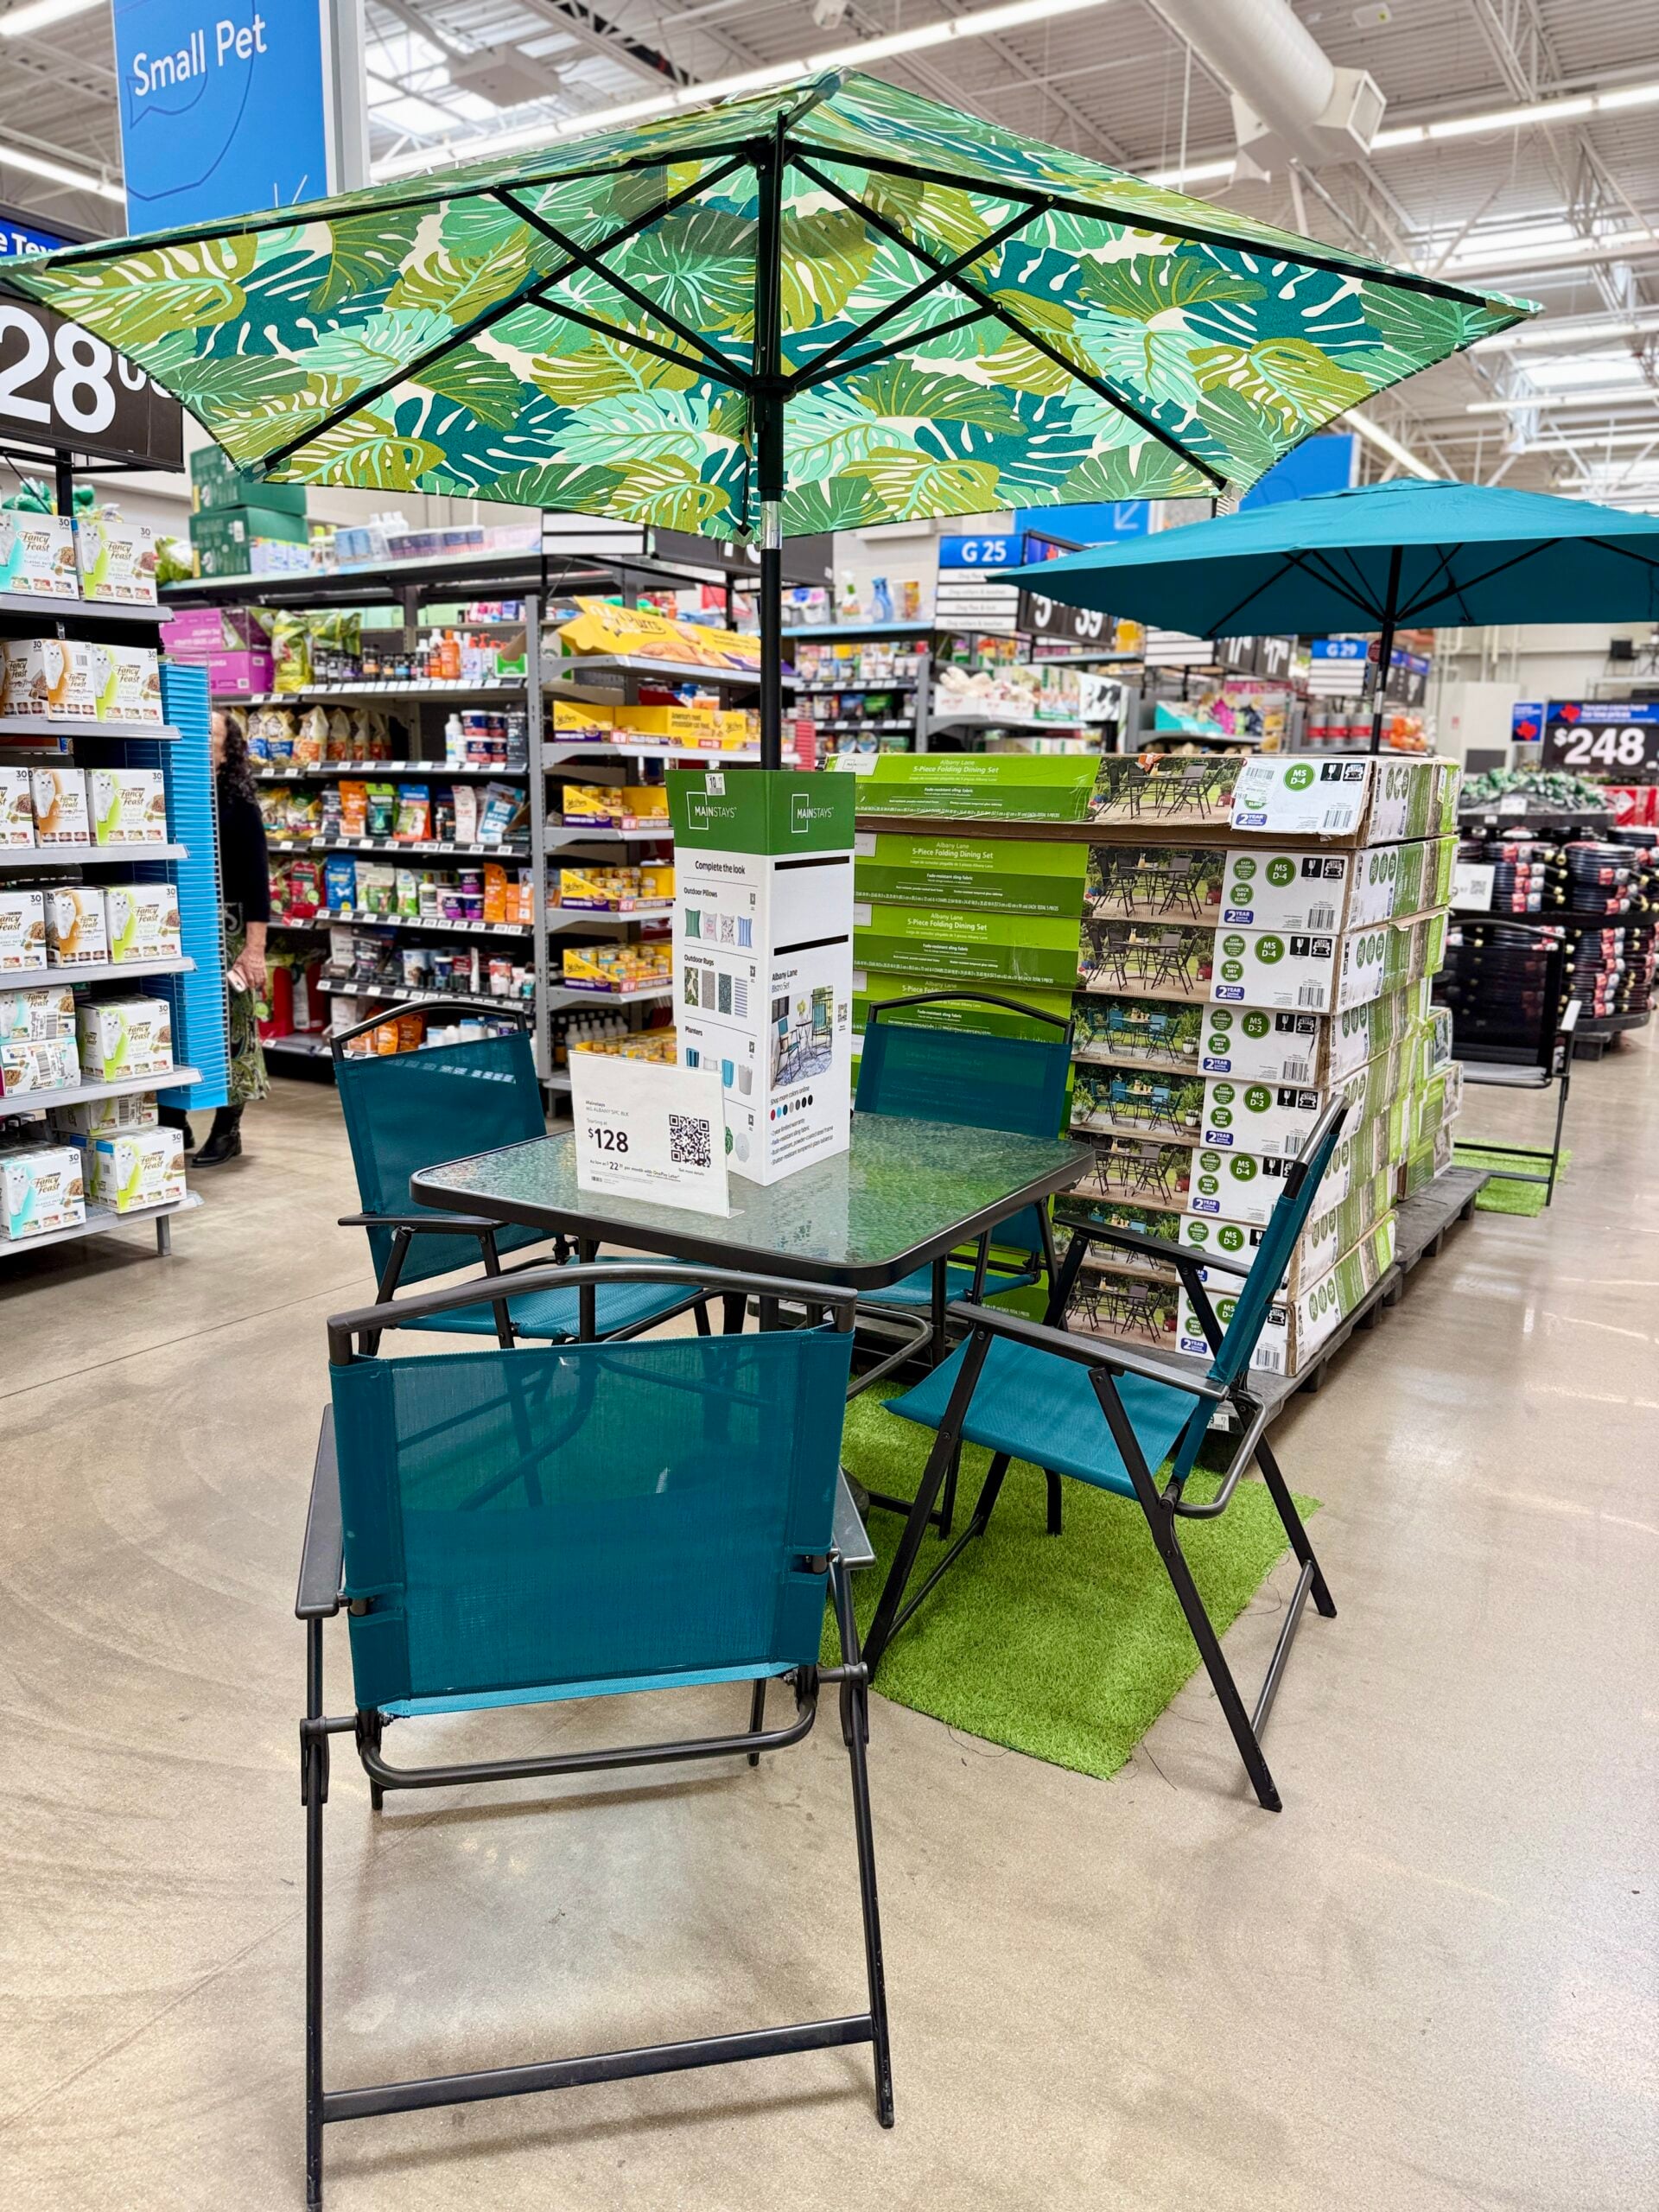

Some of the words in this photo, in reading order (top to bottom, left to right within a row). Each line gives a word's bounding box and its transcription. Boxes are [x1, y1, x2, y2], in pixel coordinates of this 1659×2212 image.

[133, 29, 206, 96] Small
[216, 14, 267, 67] Pet
[17, 531, 50, 543] Fancy
[26, 542, 50, 552] Feast
[104, 541, 132, 552] Fancy
[962, 541, 978, 563] G
[982, 541, 1007, 562] 25
[111, 550, 132, 560] Feast
[1326, 643, 1338, 657] G
[113, 666, 140, 676] Fancy
[119, 675, 140, 683] Feast
[1554, 728, 1645, 766] $248
[937, 766, 962, 774] Folding
[963, 766, 986, 774] Dining
[118, 789, 144, 799] Fancy
[123, 797, 145, 805] Feast
[695, 806, 734, 818] MAINSTAYS
[798, 808, 832, 819] MAINSTAYS
[1238, 815, 1249, 823] 2
[935, 849, 958, 858] Folding
[960, 850, 981, 859] Dining
[696, 861, 722, 873] Complete
[723, 864, 732, 873] the
[734, 865, 745, 874] look
[684, 887, 702, 896] Outdoor
[702, 889, 717, 898] Pillows
[131, 906, 159, 915] Fancy
[138, 914, 159, 923] Feast
[1227, 911, 1236, 922] 2
[930, 920, 952, 930] Folding
[955, 922, 975, 931] Dining
[684, 954, 702, 964] Outdoor
[703, 957, 715, 966] Rugs
[772, 970, 786, 982] Albany
[787, 969, 798, 978] Lane
[1218, 987, 1226, 997] 2
[124, 1025, 150, 1034] Fancy
[685, 1026, 702, 1037] Planters
[130, 1032, 151, 1040] Feast
[1205, 1059, 1214, 1070] 2
[588, 1128, 628, 1153] $128
[1209, 1132, 1217, 1142] 2
[30, 1176, 60, 1188] Fancy
[38, 1184, 60, 1195] Feast
[1195, 1199, 1203, 1210] 2
[1183, 1340, 1191, 1350] 2
